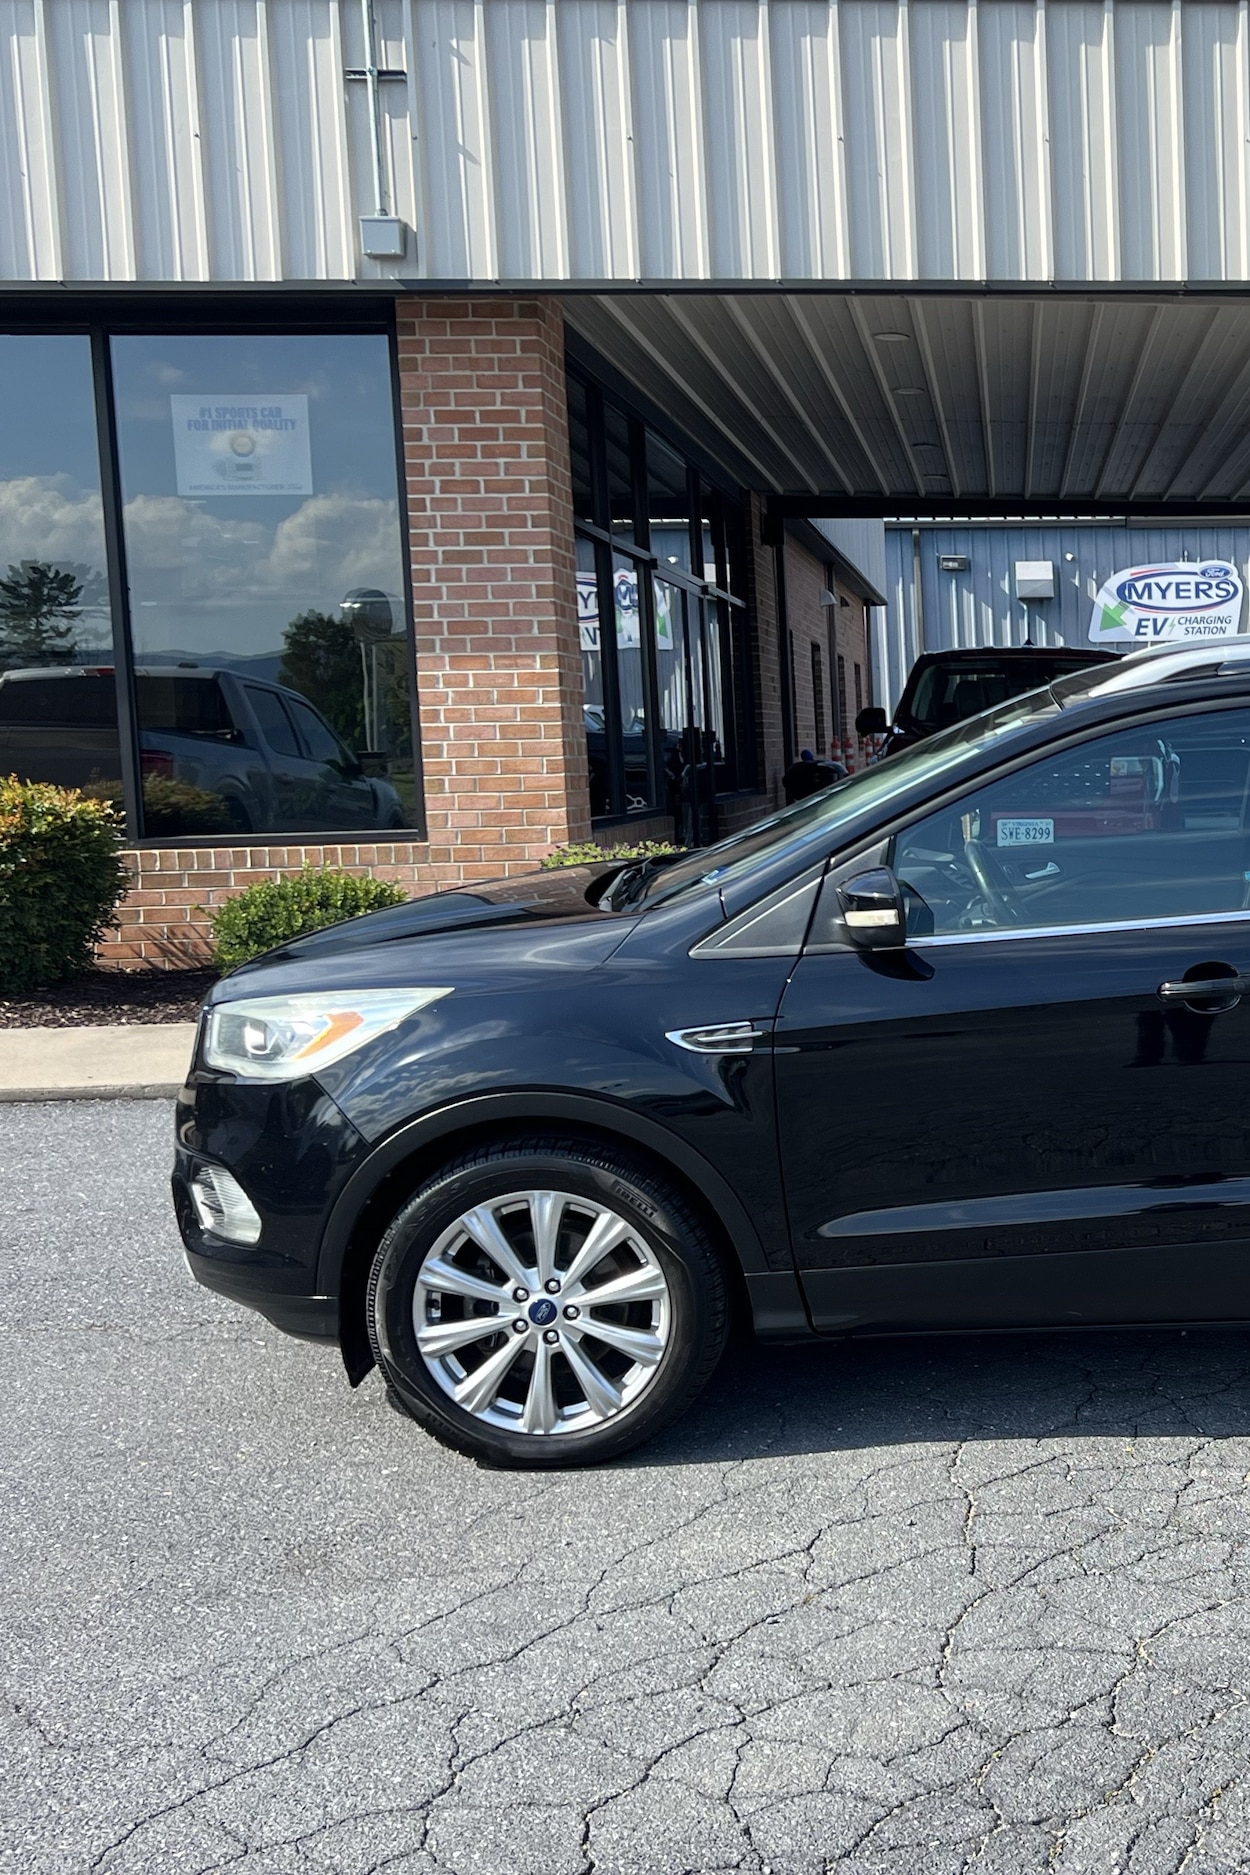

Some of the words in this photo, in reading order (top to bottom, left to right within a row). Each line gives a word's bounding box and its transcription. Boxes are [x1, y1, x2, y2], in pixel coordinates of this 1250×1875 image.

[215, 406, 258, 419] SPORTS
[260, 406, 282, 418] CAR
[187, 419, 210, 432] FOR
[212, 419, 248, 431] INITIAL
[252, 418, 297, 432] QUALITY
[1205, 567, 1226, 577] Ford
[1126, 581, 1232, 601] MYERS
[1135, 617, 1169, 637] EV
[1177, 615, 1232, 625] CHARGING
[1184, 625, 1227, 636] STATION
[1001, 827, 1051, 840] SWE-8299
